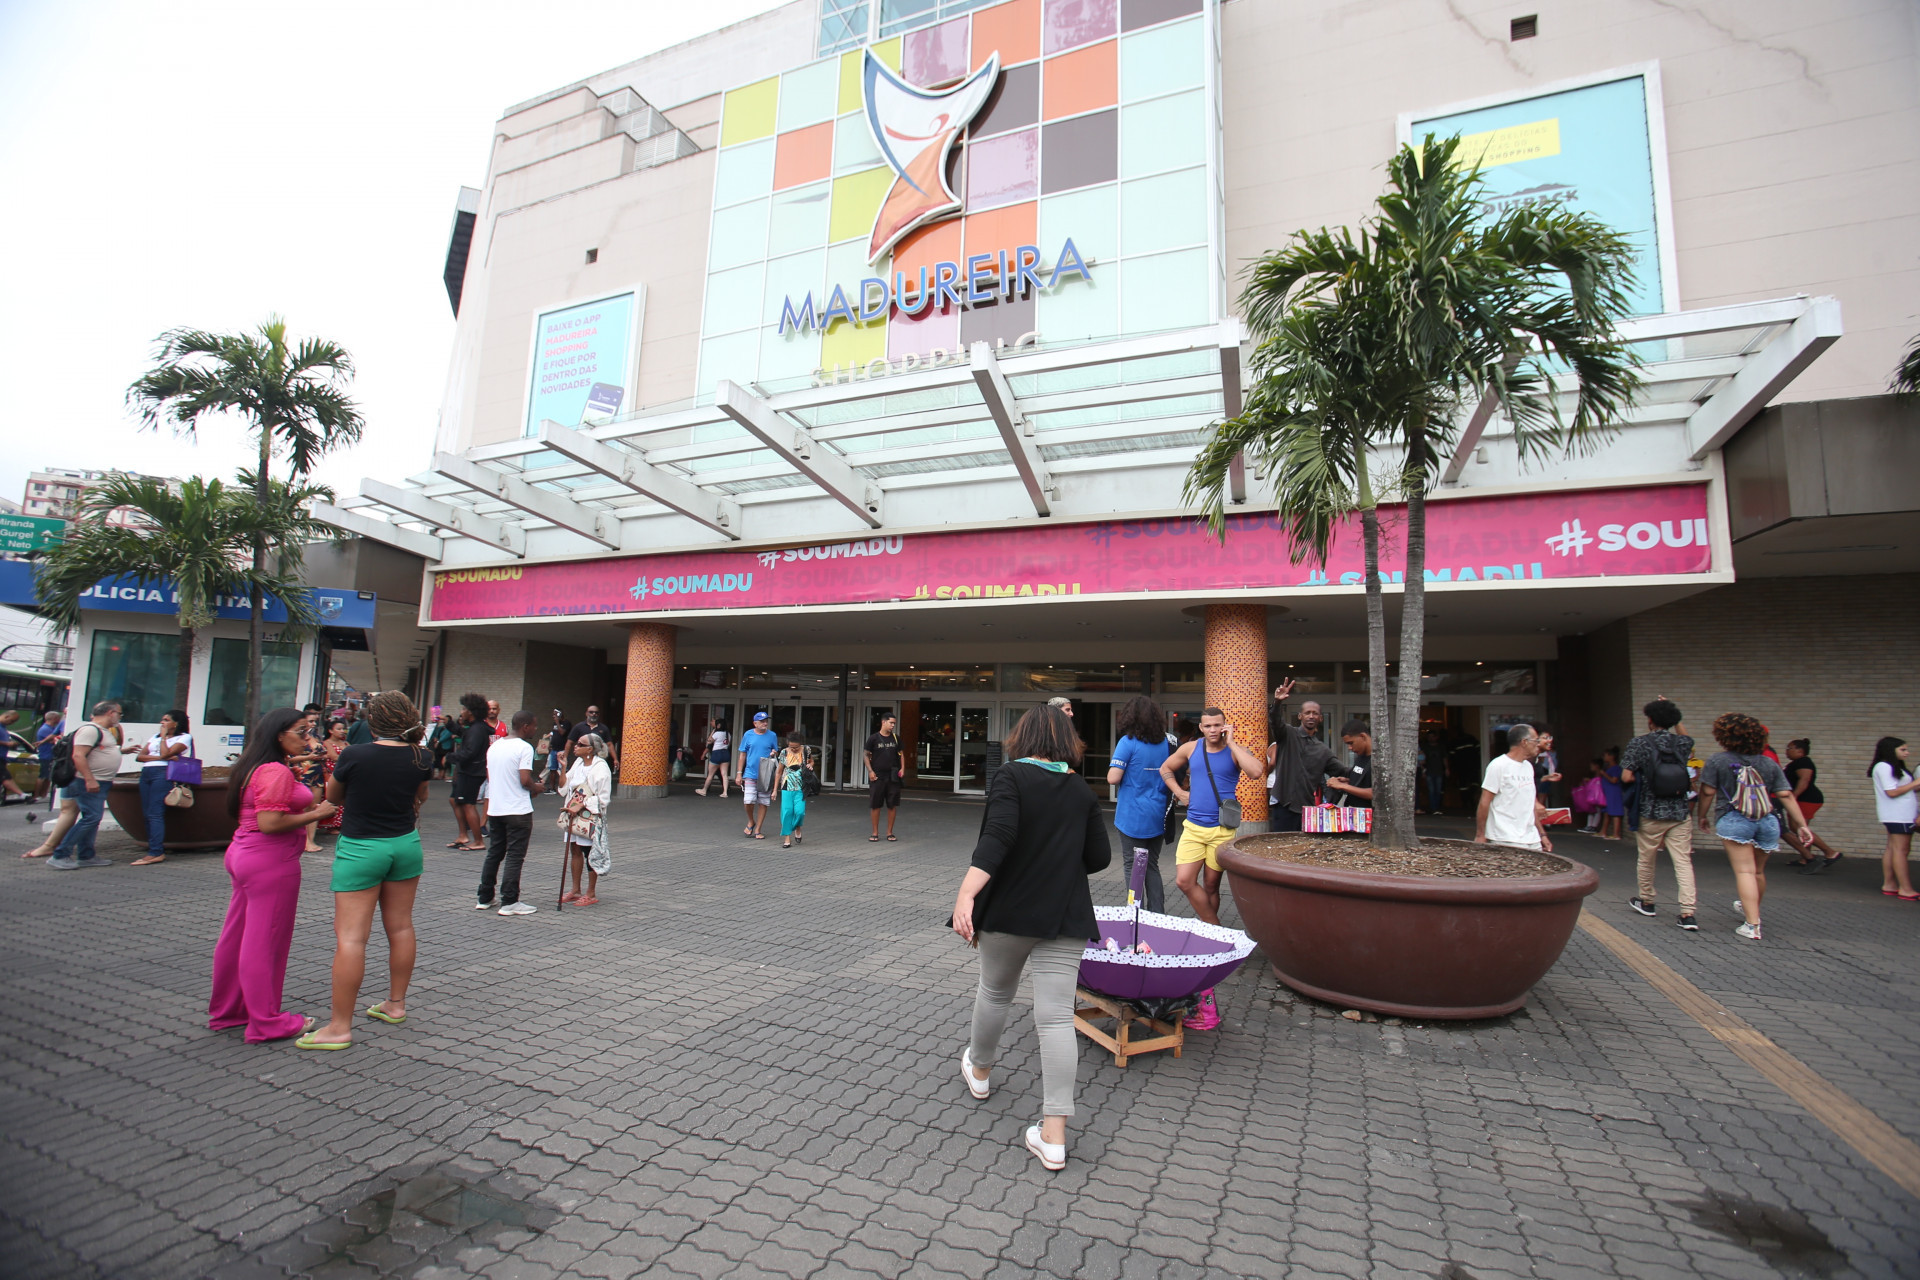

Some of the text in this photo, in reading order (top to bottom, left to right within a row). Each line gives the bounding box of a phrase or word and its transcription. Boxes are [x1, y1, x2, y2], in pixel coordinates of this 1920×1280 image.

[1489, 146, 1541, 161] SHOPPING
[777, 237, 1093, 335] MADUREIRA
[547, 313, 601, 333] BAIXE O APP
[546, 327, 598, 345] MADUREIRA
[544, 341, 589, 358] SHOPPING
[543, 352, 596, 370] E FIQUE POR
[541, 364, 597, 383] DENTRO DAS
[540, 378, 591, 395] NOVIDADES
[0, 529, 34, 540] Gurgel
[8, 540, 32, 549] Neto
[629, 573, 753, 601] #SOUMADU
